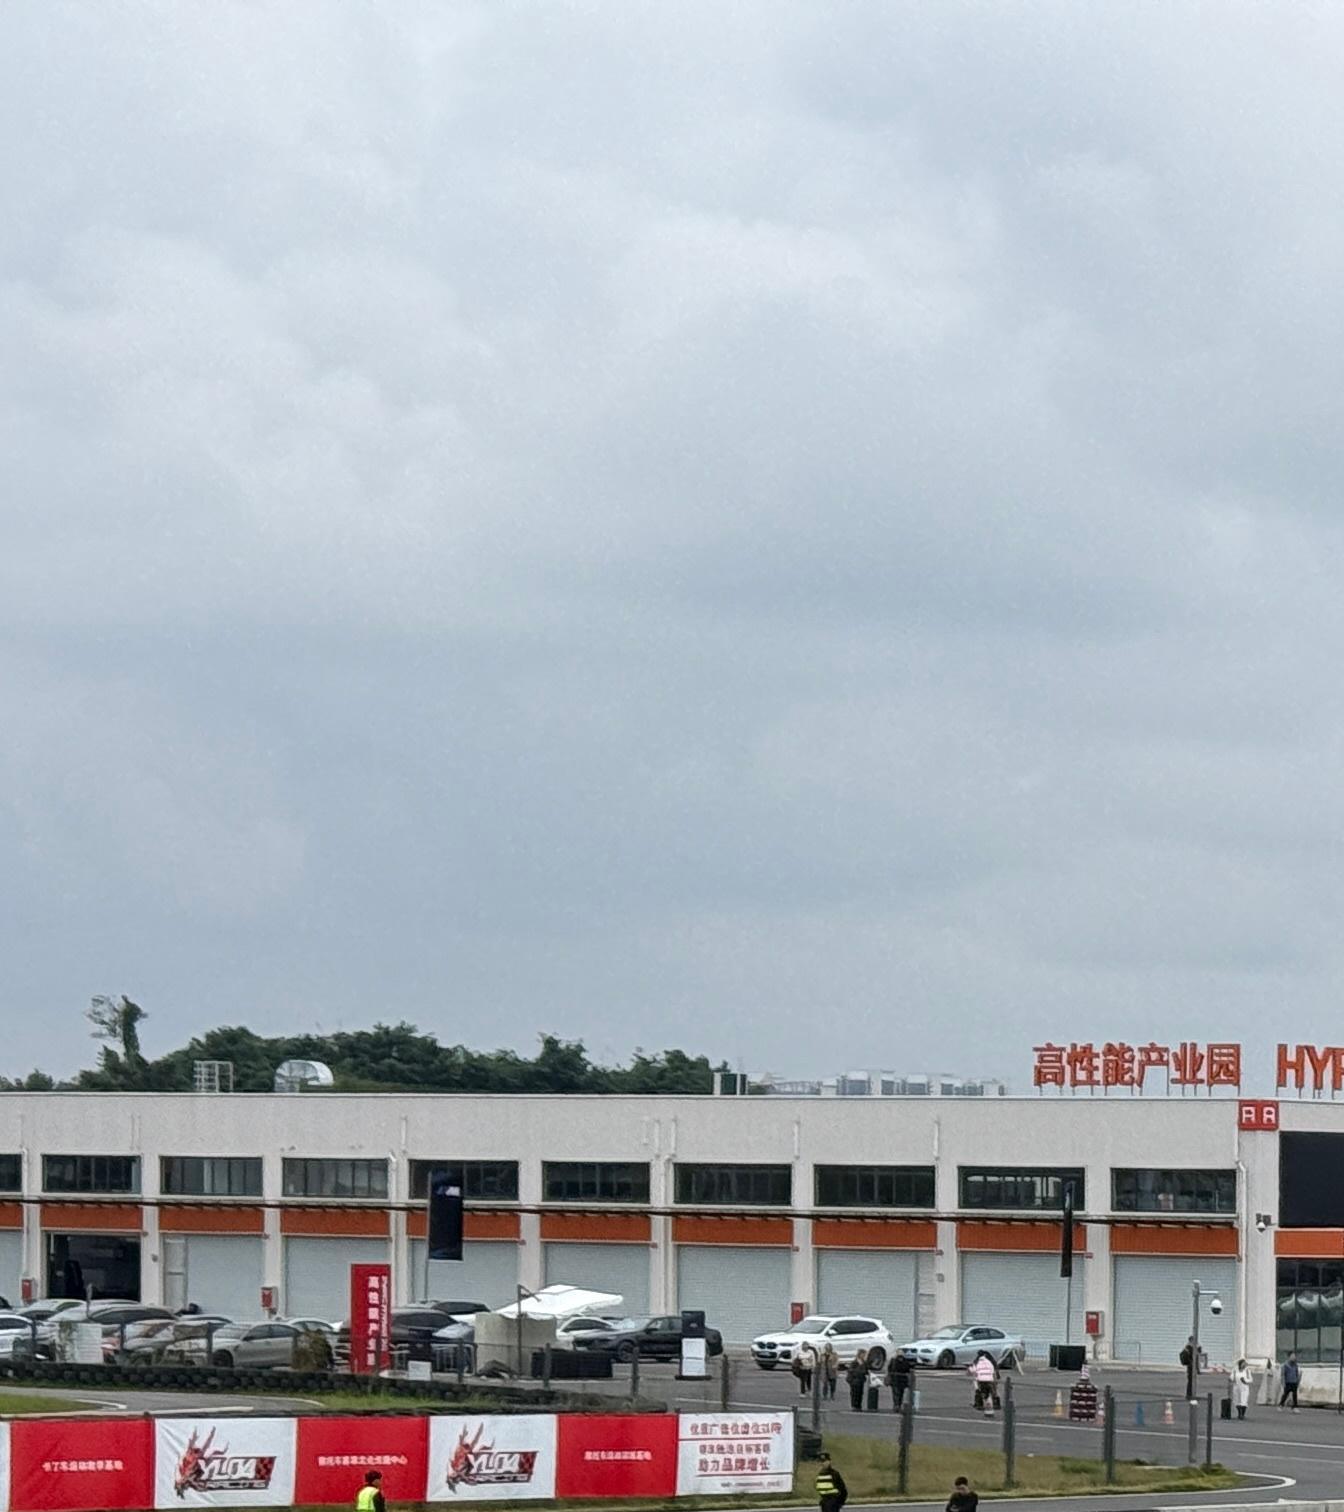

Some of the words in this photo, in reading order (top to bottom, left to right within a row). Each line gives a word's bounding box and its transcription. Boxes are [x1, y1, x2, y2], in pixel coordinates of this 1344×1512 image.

[1033, 1042, 1241, 1087] 高性能产业园
[697, 1457, 770, 1472] 助力品牌增长
